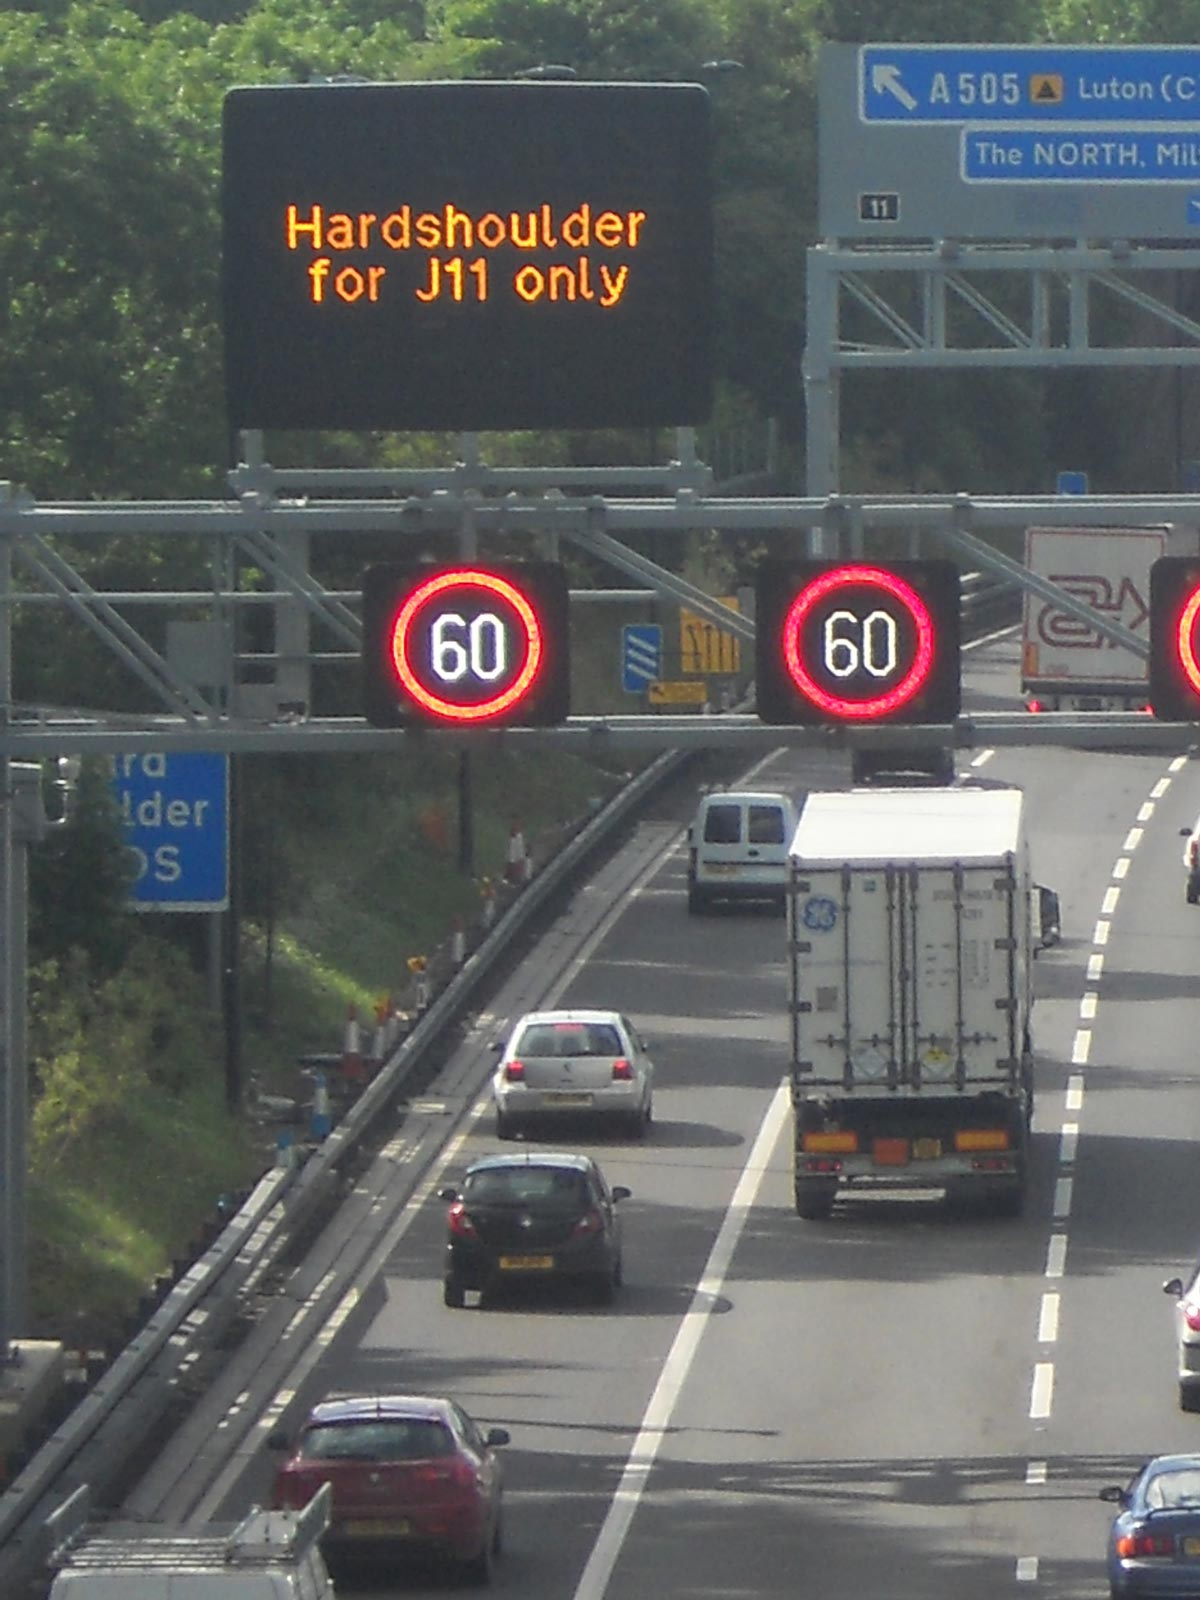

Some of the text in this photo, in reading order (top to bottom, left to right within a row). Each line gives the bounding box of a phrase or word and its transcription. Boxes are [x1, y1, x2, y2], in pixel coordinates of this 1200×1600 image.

[930, 73, 1019, 104] A505
[1079, 77, 1152, 100] Luton
[976, 142, 1023, 165] The
[286, 203, 647, 251] Hardshoulder
[871, 200, 888, 217] 11
[308, 257, 630, 308] for J11 only
[431, 612, 507, 683] 60
[823, 609, 898, 678] 60
